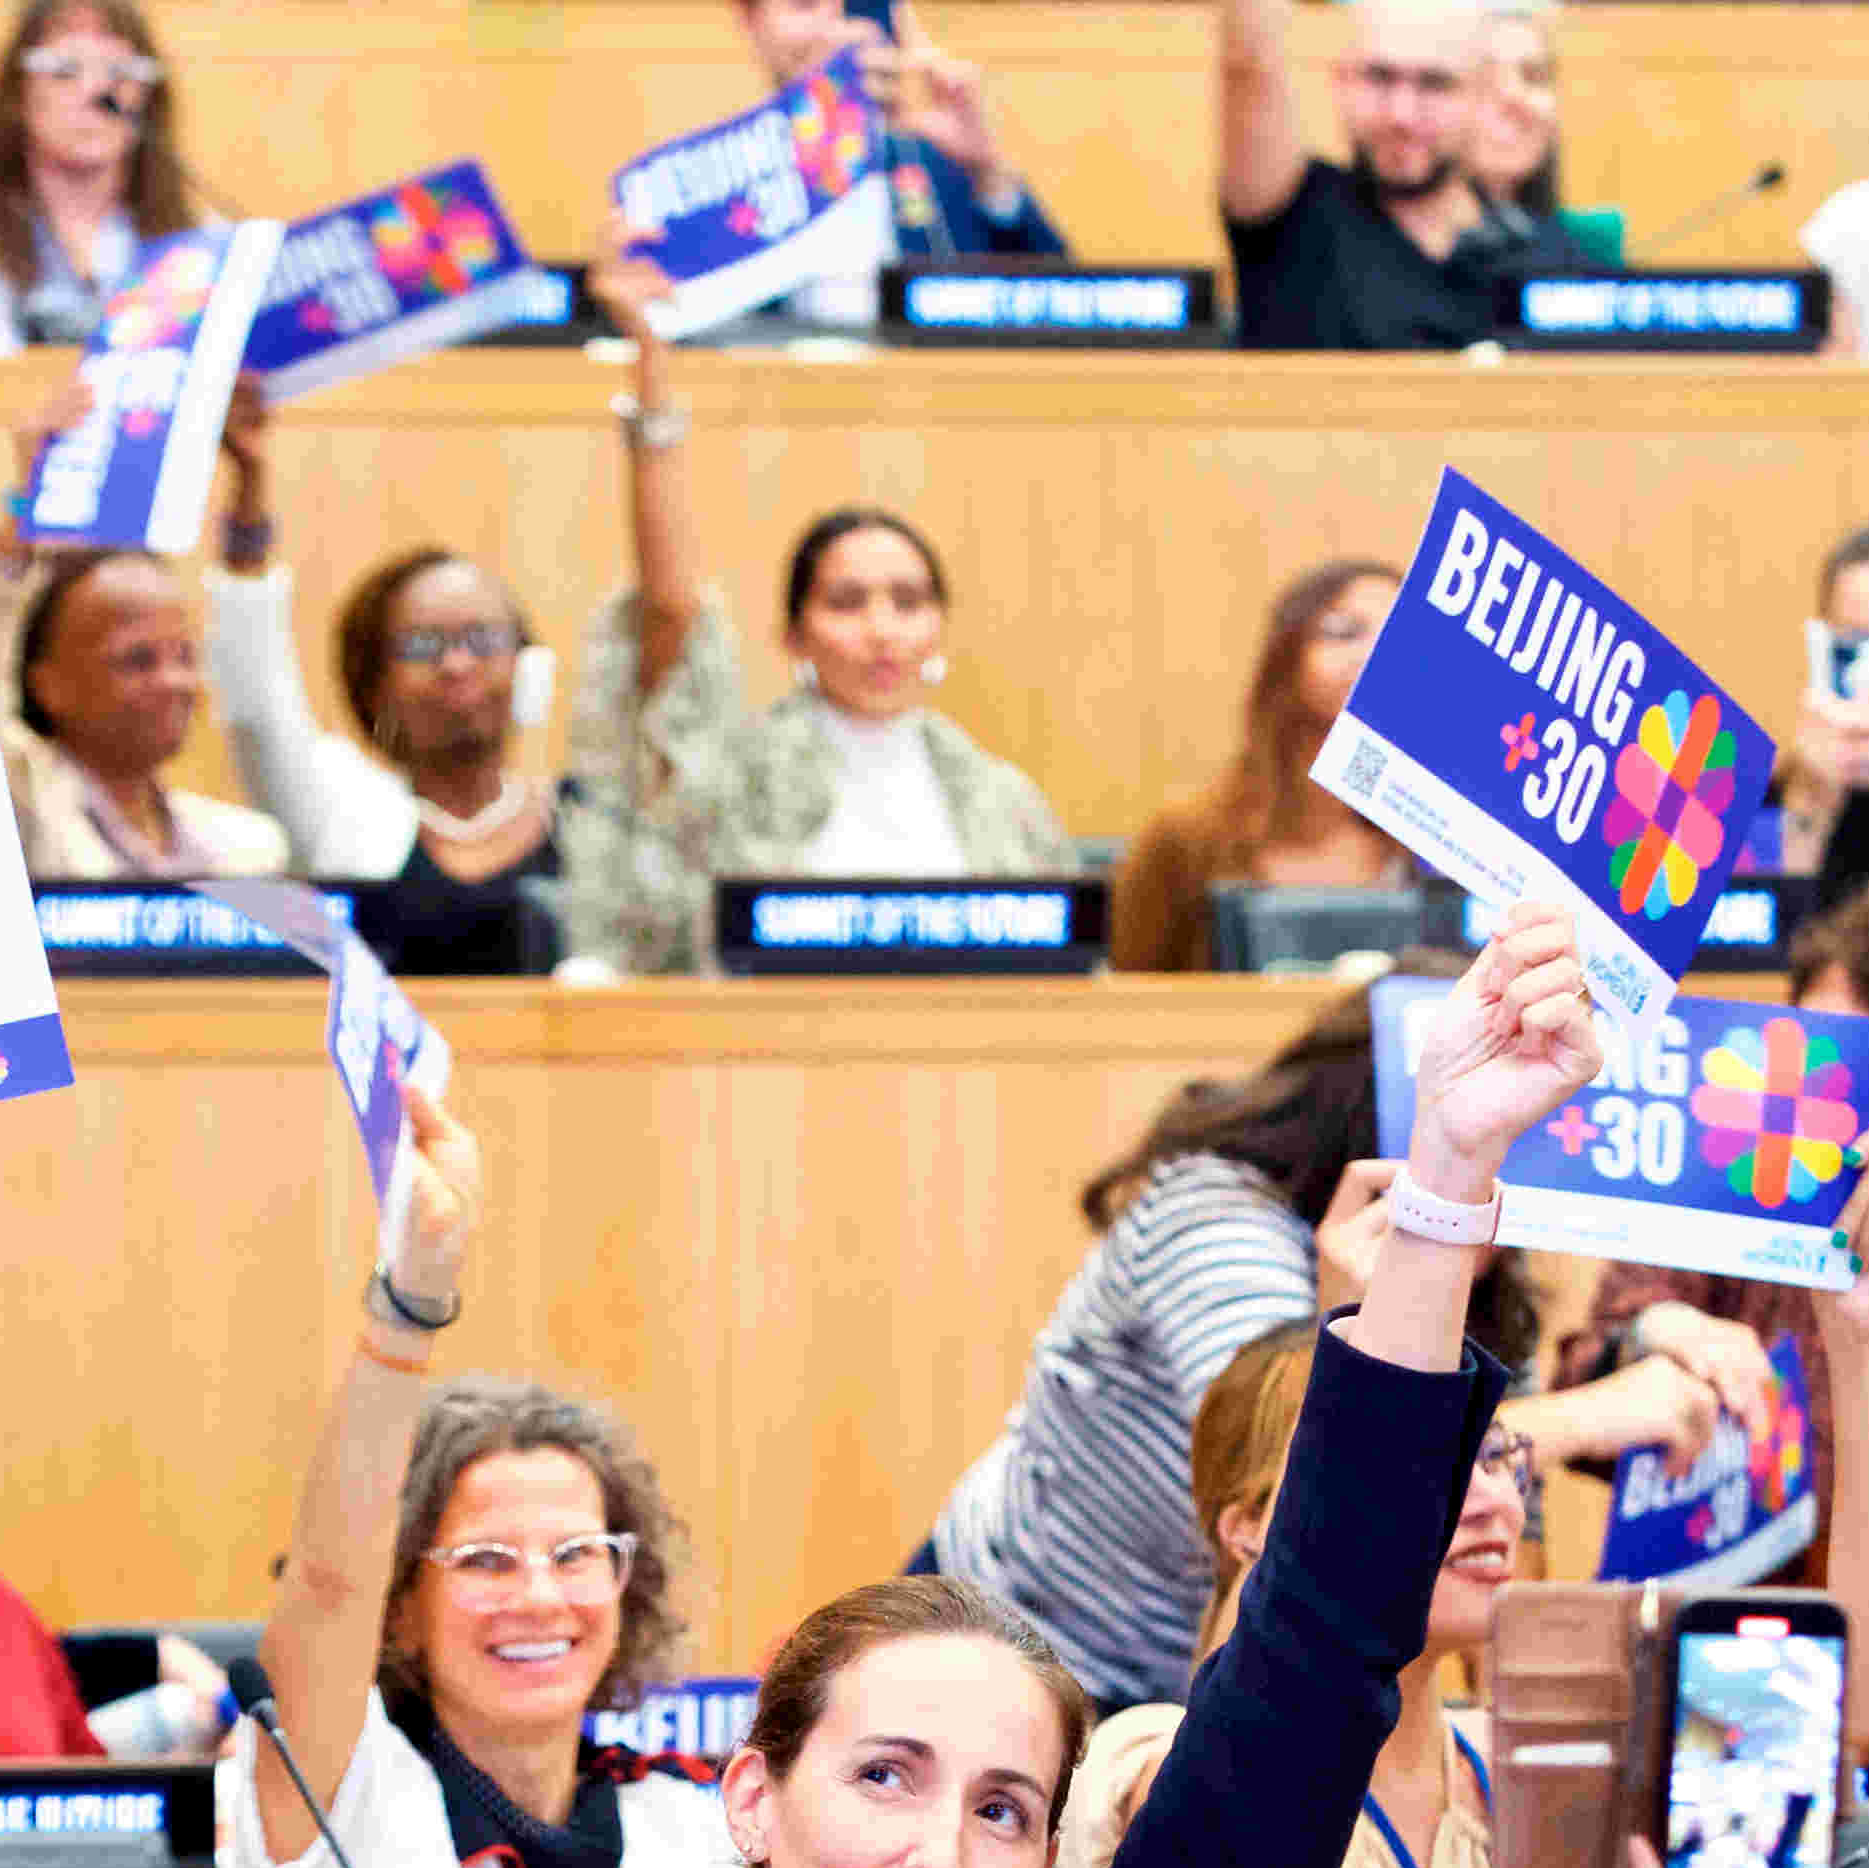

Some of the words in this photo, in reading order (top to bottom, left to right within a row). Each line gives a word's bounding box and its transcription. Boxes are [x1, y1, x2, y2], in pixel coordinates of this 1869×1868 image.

[1427, 507, 1647, 747] BEIJING
[1500, 713, 1606, 845] +30
[1548, 1095, 1688, 1187] +30
